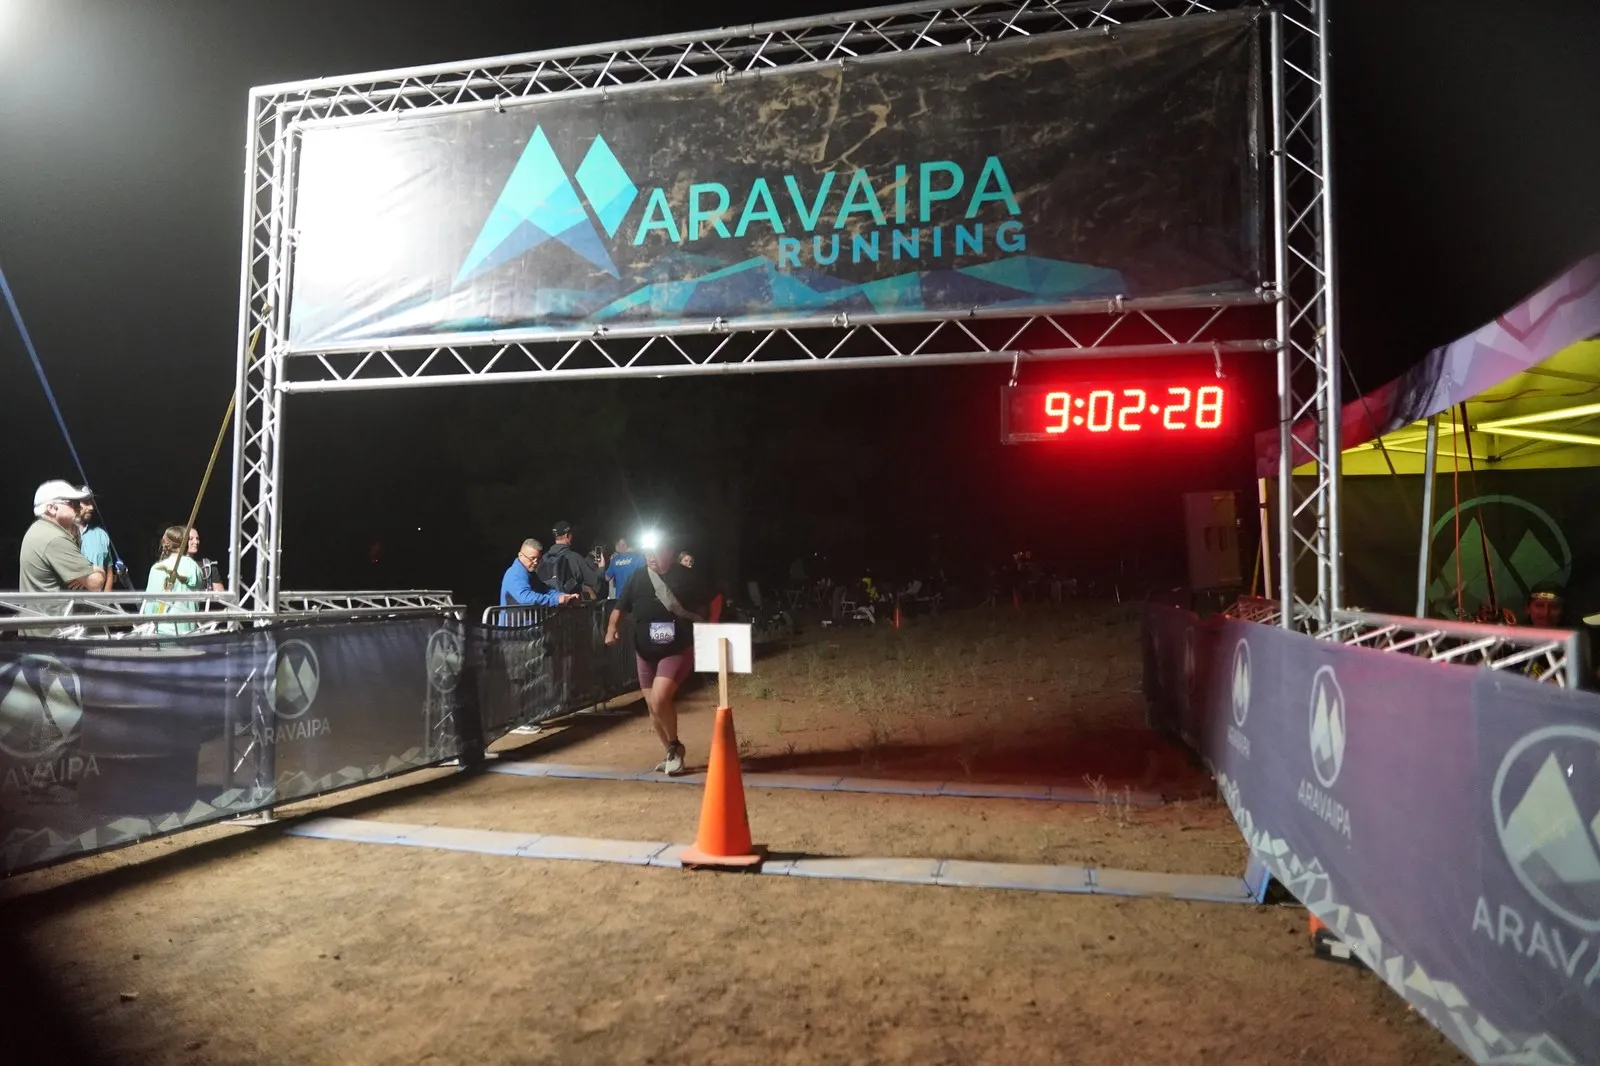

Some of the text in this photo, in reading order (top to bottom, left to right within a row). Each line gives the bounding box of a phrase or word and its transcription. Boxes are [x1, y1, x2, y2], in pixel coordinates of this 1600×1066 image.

[633, 155, 1021, 246] ARAVAIPA
[778, 220, 1027, 268] RUNNING
[252, 717, 332, 747] ARAVAIPA
[1298, 778, 1352, 840] ARAVAIPA
